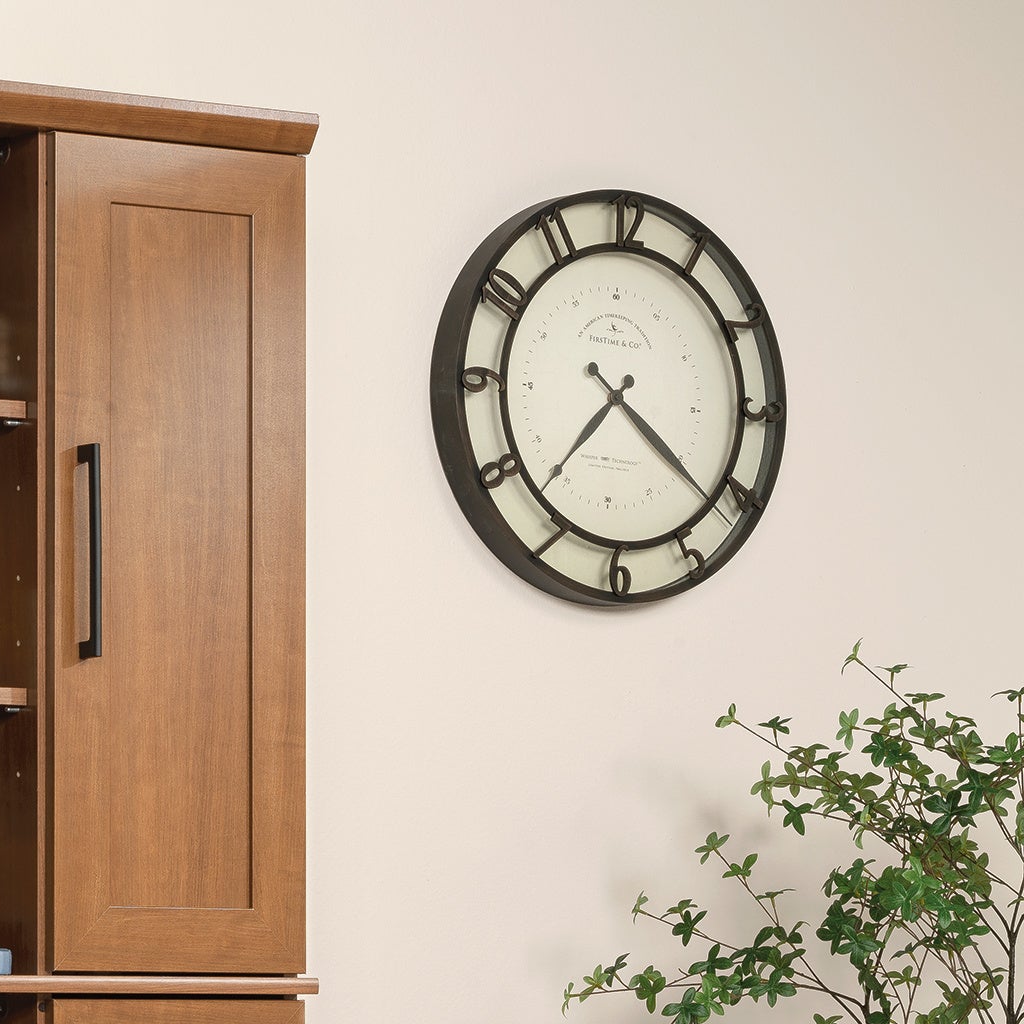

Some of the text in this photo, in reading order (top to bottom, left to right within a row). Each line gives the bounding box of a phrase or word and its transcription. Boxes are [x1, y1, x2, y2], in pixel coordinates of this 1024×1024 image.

[536, 205, 576, 265] 11
[609, 194, 645, 248] 12
[683, 232, 711, 275] 1
[481, 268, 528, 320] 10
[725, 302, 764, 342] 2
[462, 366, 506, 393] 9
[743, 396, 784, 423] 3
[480, 452, 522, 490] 8
[726, 475, 764, 513] 4
[533, 513, 571, 558] 7
[675, 528, 706, 580] 5
[609, 545, 631, 597] 6
